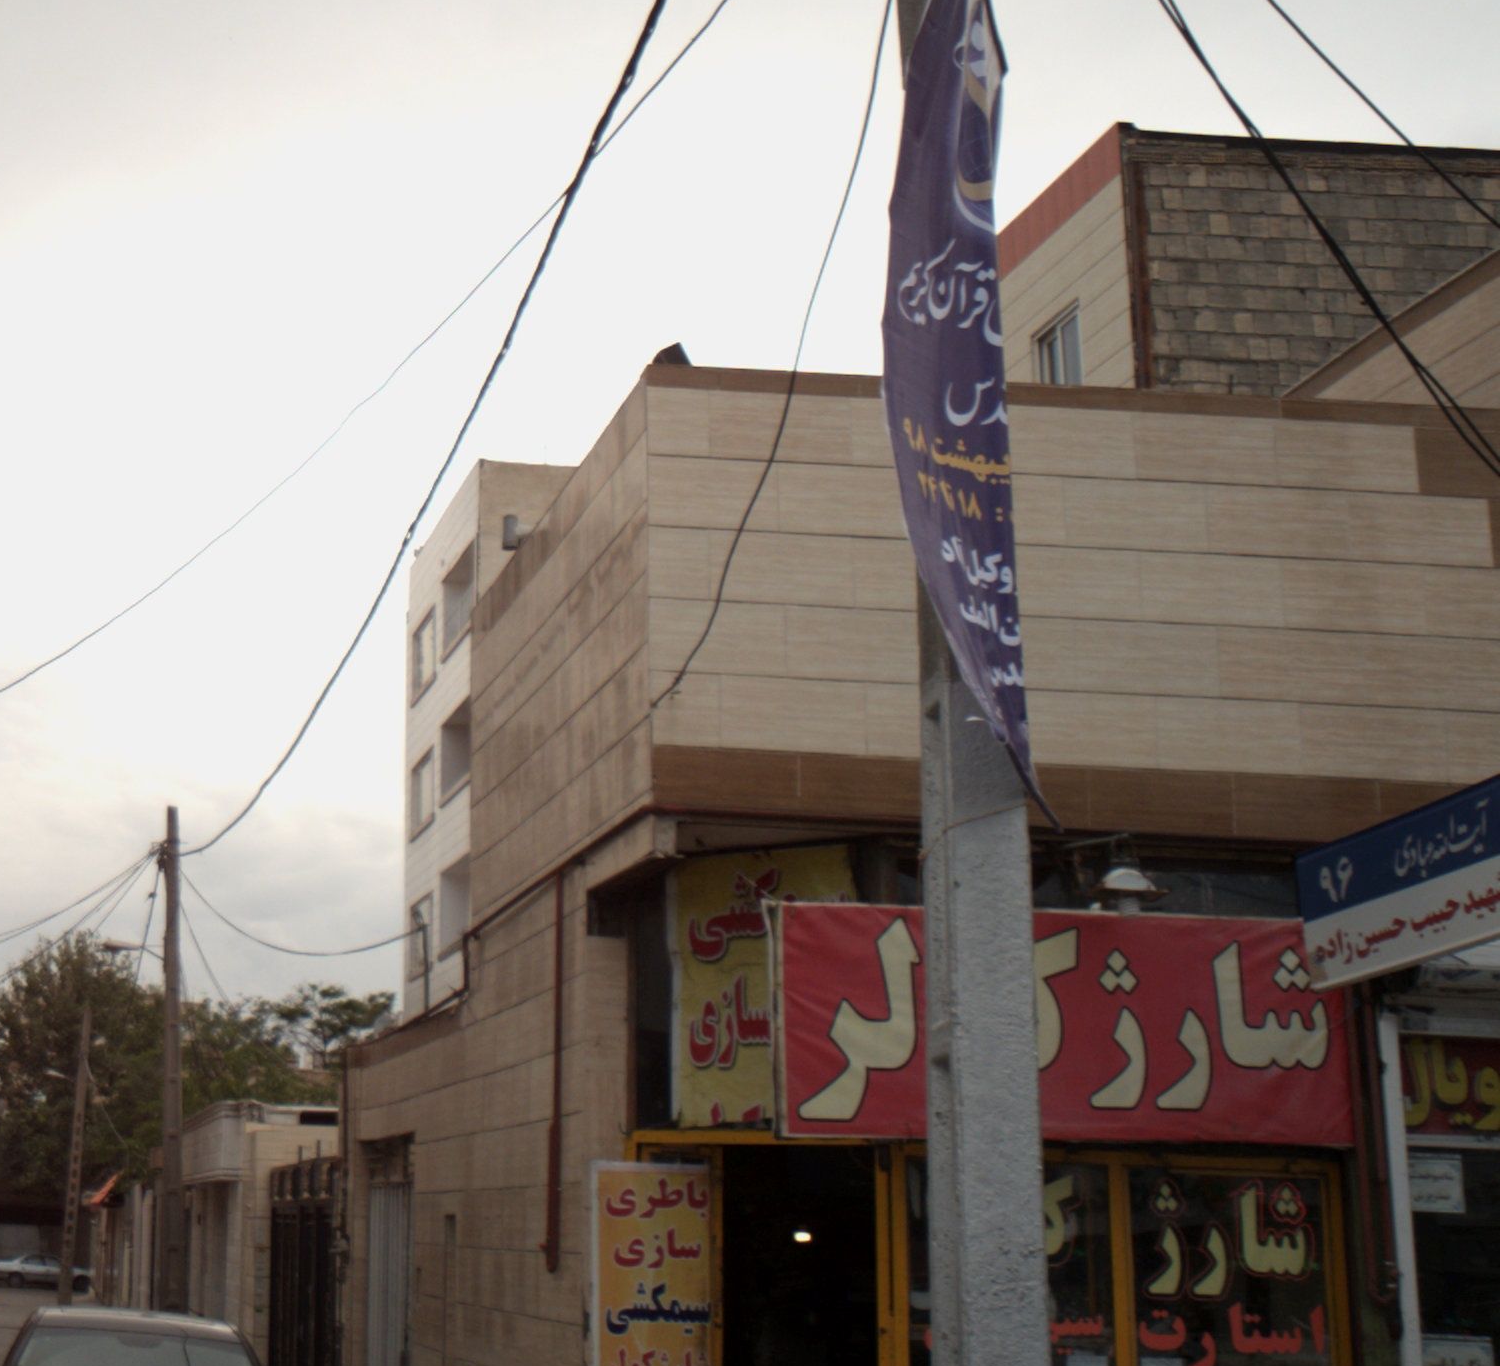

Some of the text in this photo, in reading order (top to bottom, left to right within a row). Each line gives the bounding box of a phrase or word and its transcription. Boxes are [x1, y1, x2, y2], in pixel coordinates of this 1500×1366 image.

[897, 237, 957, 325] کریم
[927, 259, 997, 329] قرآن
[1319, 856, 1353, 903] ۹۶
[1356, 918, 1406, 959] حسین
[1411, 899, 1460, 938] حبیب
[799, 916, 1329, 1122] شارژ کلر
[606, 1178, 708, 1218] باطری
[614, 1228, 701, 1268] سازی
[1144, 1180, 1311, 1298] شارژ
[606, 1283, 711, 1334] سیمکشی
